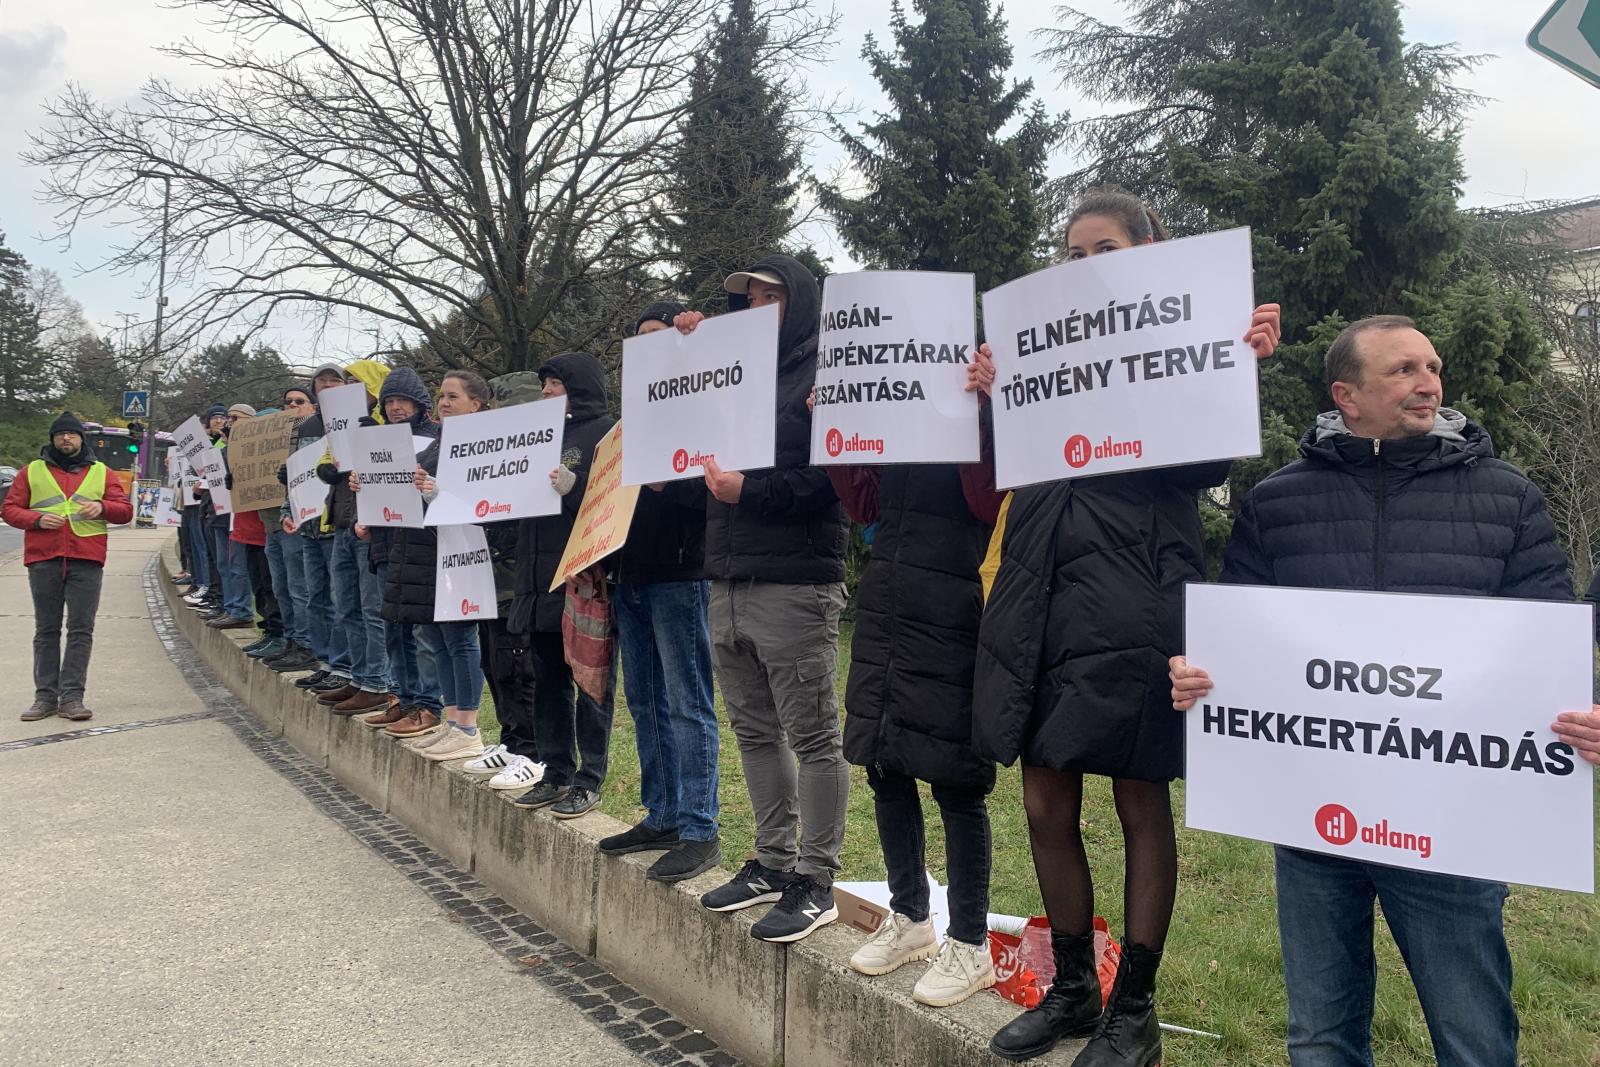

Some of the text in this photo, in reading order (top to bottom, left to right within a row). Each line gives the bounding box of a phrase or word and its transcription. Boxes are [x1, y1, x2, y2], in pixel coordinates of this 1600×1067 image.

[1017, 293, 1192, 358] ELNÉMÍTÁSI
[816, 338, 970, 371] DÍJPÉNZTÁRAK
[648, 360, 743, 403] KORRUPCIÓ
[1001, 339, 1235, 411] TÖRVÉNY TERVE
[370, 448, 393, 463] ROGÁN
[449, 428, 554, 459] REKORD MAGAS
[466, 455, 529, 483] INFLÁCIÓ
[442, 548, 490, 569] HATVANPUSZTA
[1306, 658, 1443, 700] OROSZ
[1202, 703, 1575, 776] HEKKERTÁMADÁS
